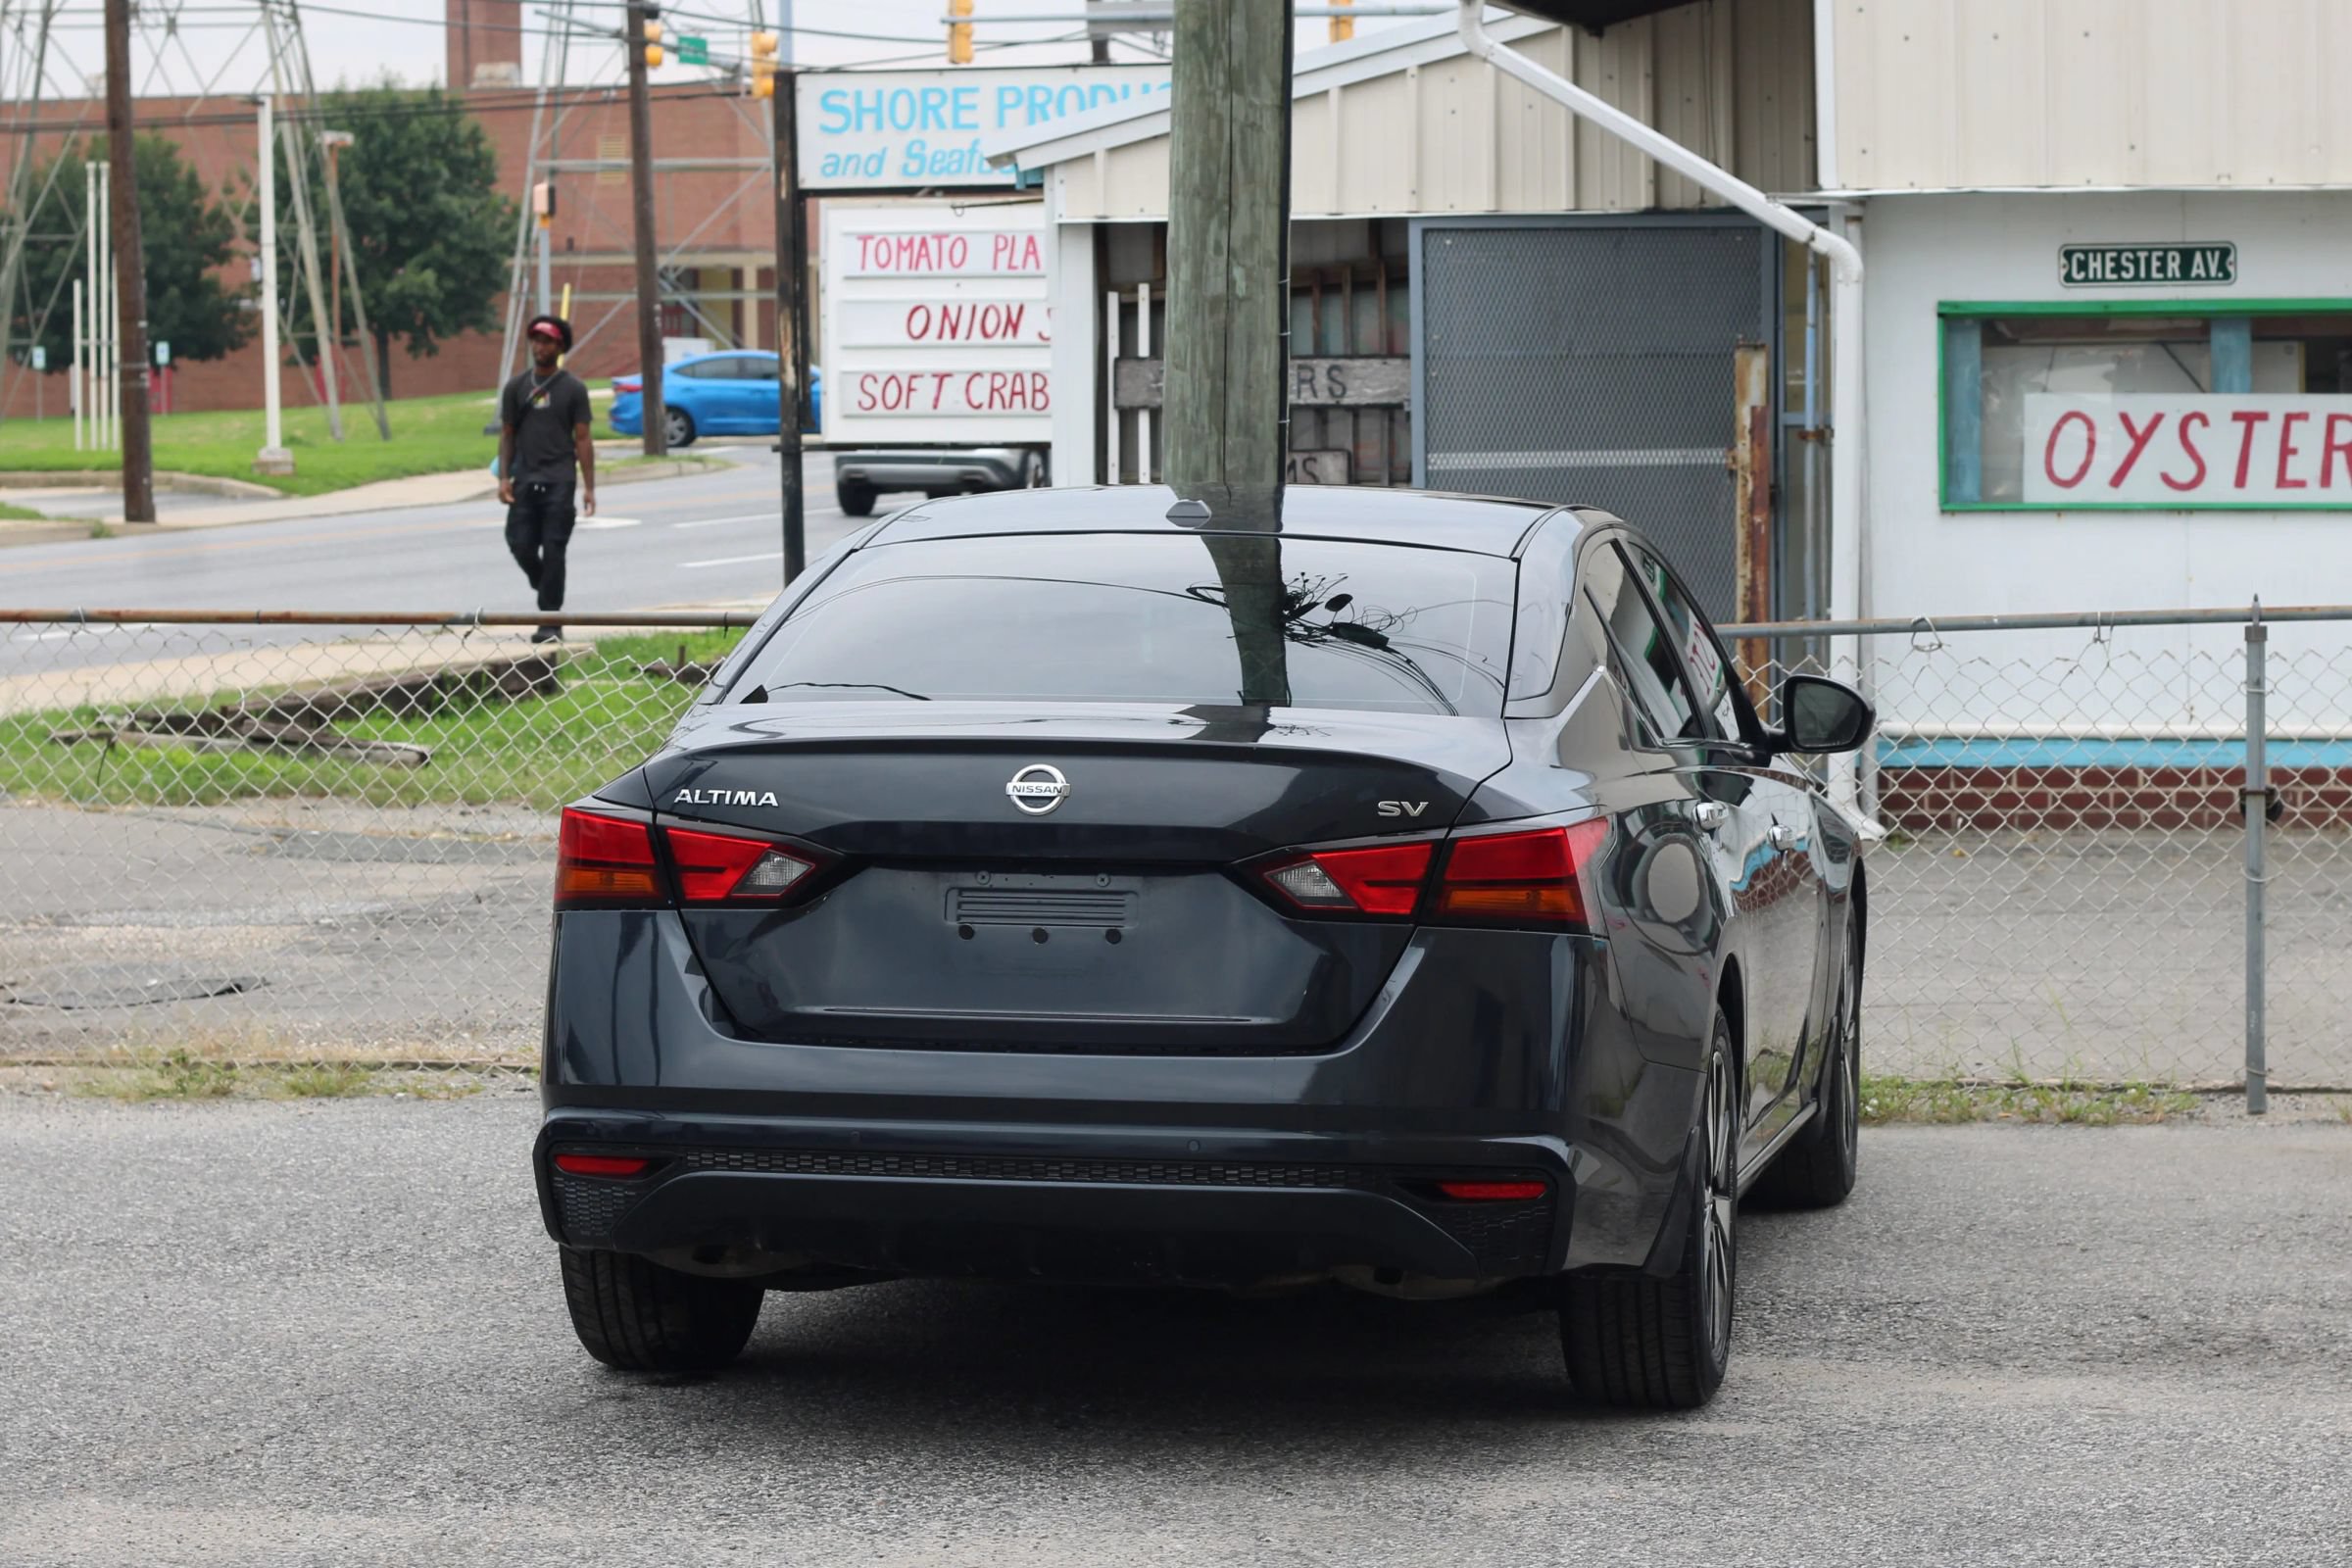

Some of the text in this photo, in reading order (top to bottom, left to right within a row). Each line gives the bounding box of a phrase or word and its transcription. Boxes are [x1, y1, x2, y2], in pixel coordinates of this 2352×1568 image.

[818, 86, 980, 134] SHORE
[820, 146, 888, 178] and
[857, 233, 1041, 271] TOMATO PLA
[2070, 250, 2224, 281] CHESTER AV.
[858, 371, 1051, 412] SOFT CRAB
[2043, 410, 2352, 491] OYSTER
[673, 788, 779, 808] ALTIMA
[1012, 784, 1062, 794] NISSAN
[1377, 800, 1429, 817] SV
